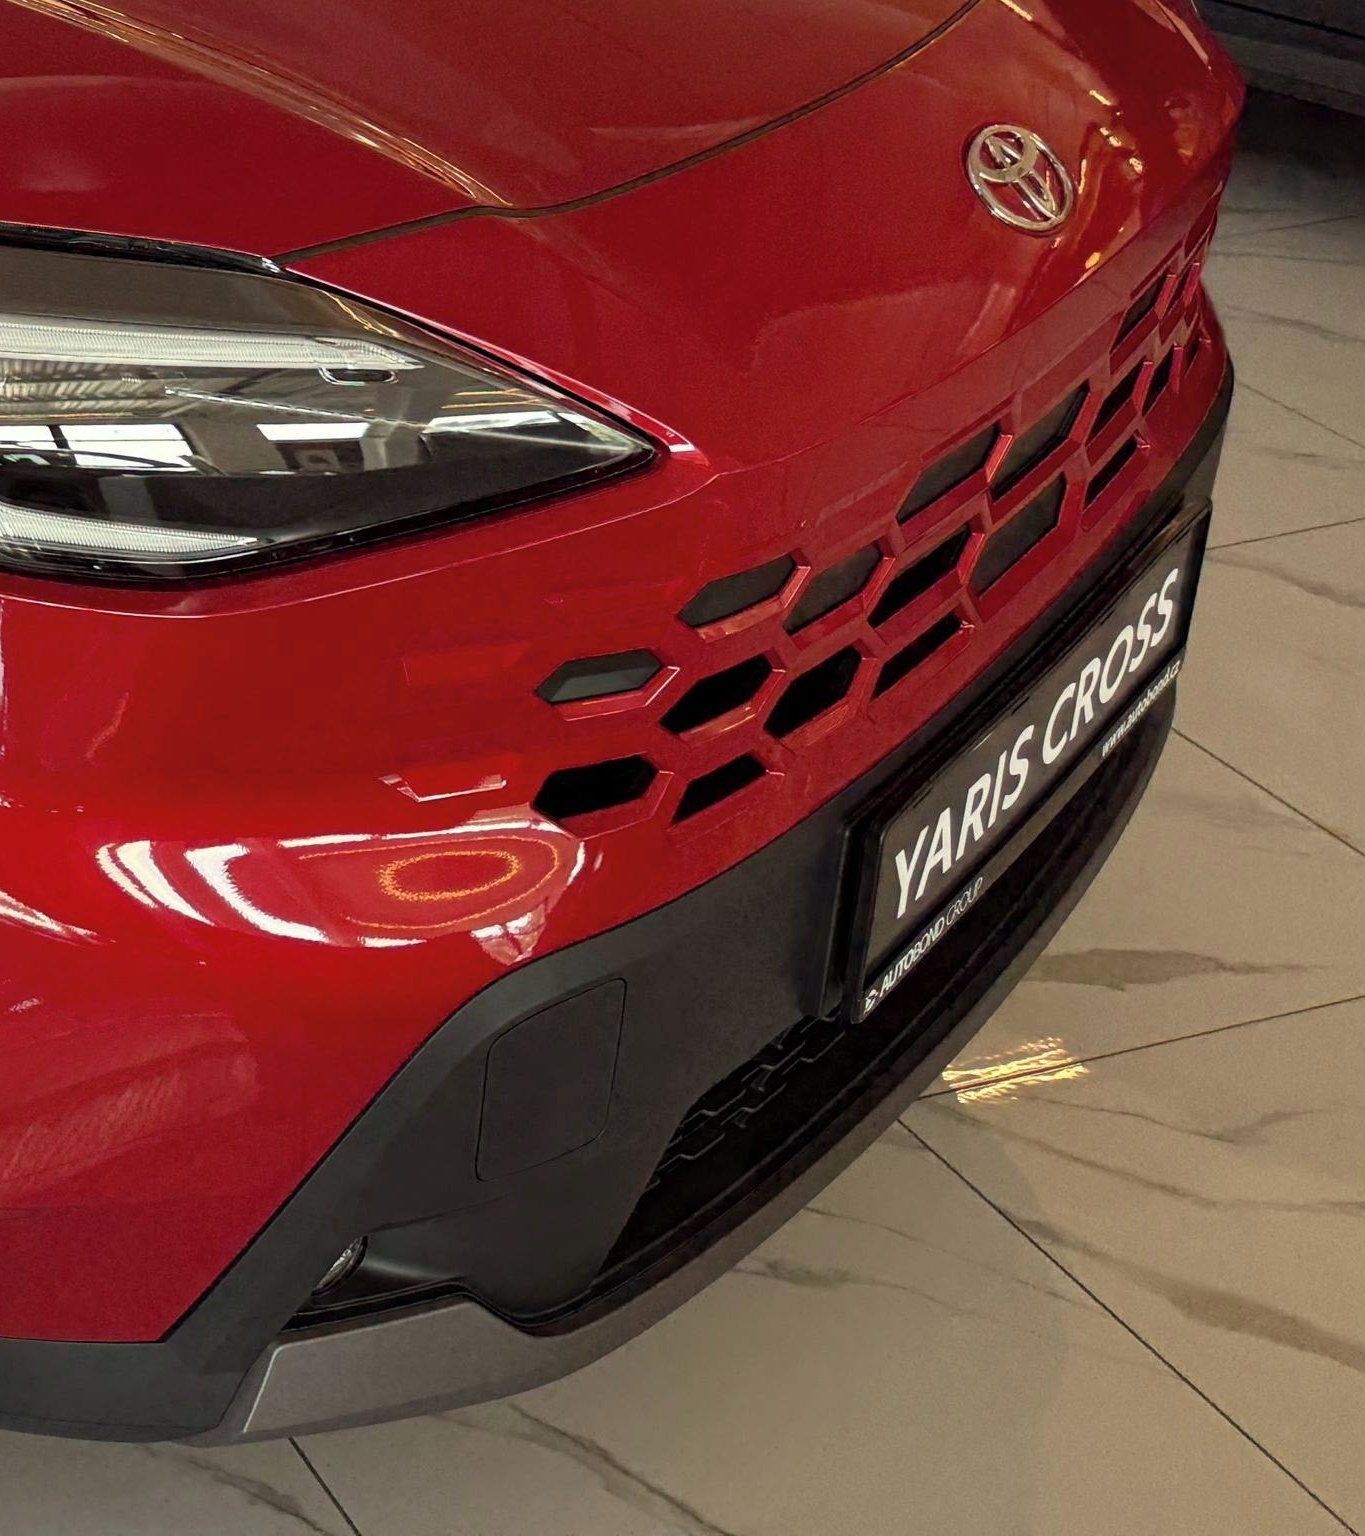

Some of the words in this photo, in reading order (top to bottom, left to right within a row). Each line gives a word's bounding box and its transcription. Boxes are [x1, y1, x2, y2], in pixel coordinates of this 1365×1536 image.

[893, 724, 1035, 920] YARIS
[1042, 568, 1179, 765] CROSS
[879, 916, 945, 998] AUTOBOND
[946, 876, 984, 926] GROUP
